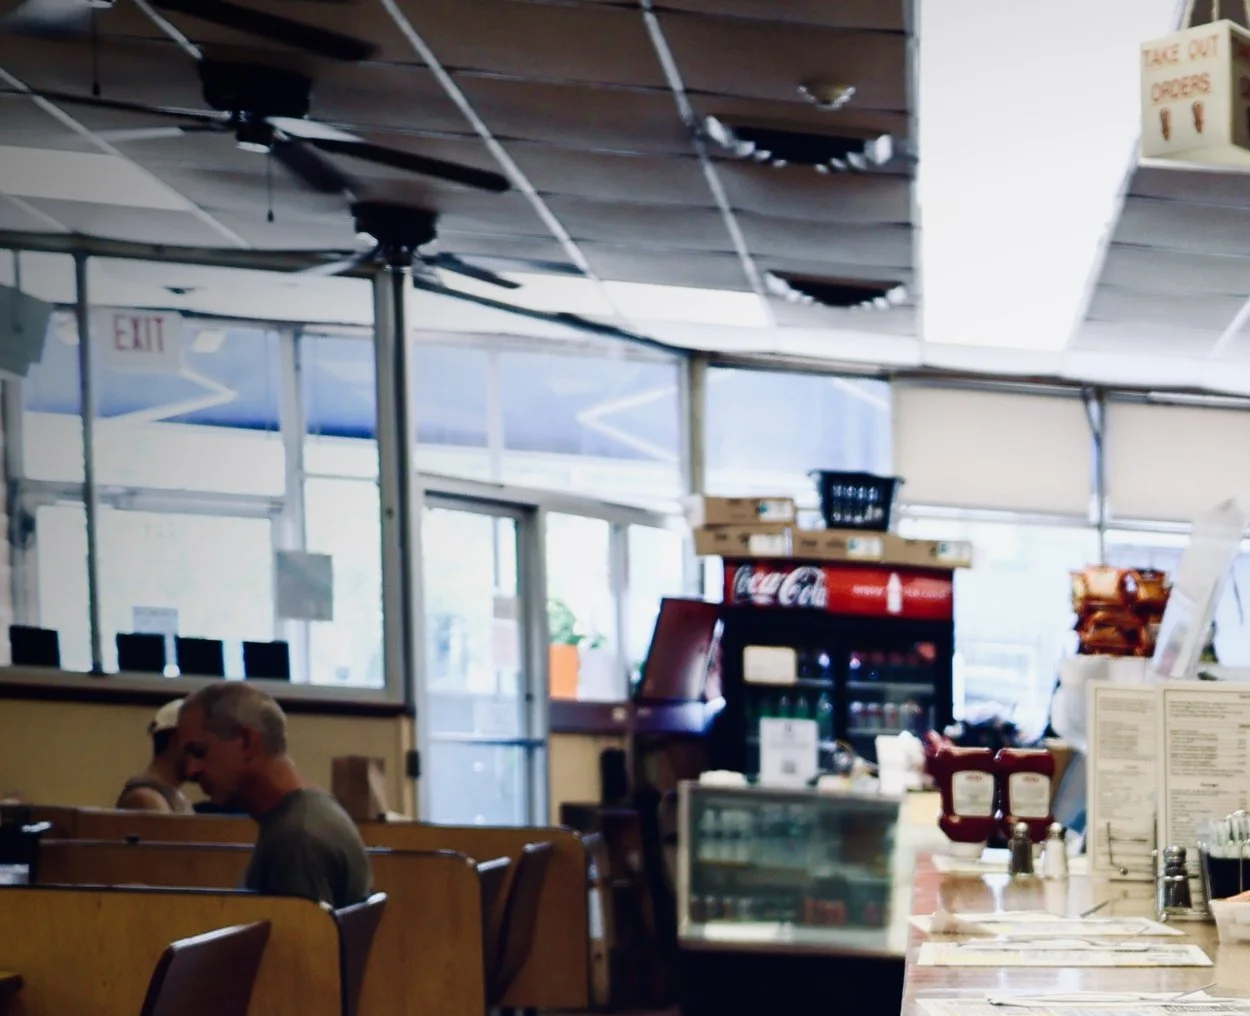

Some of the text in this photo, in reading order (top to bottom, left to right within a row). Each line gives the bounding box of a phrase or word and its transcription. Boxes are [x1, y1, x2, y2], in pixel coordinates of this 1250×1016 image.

[1142, 44, 1180, 69] TAKE
[1188, 34, 1219, 61] OUT
[1151, 73, 1211, 102] ORDERS
[113, 314, 164, 352] EXIT
